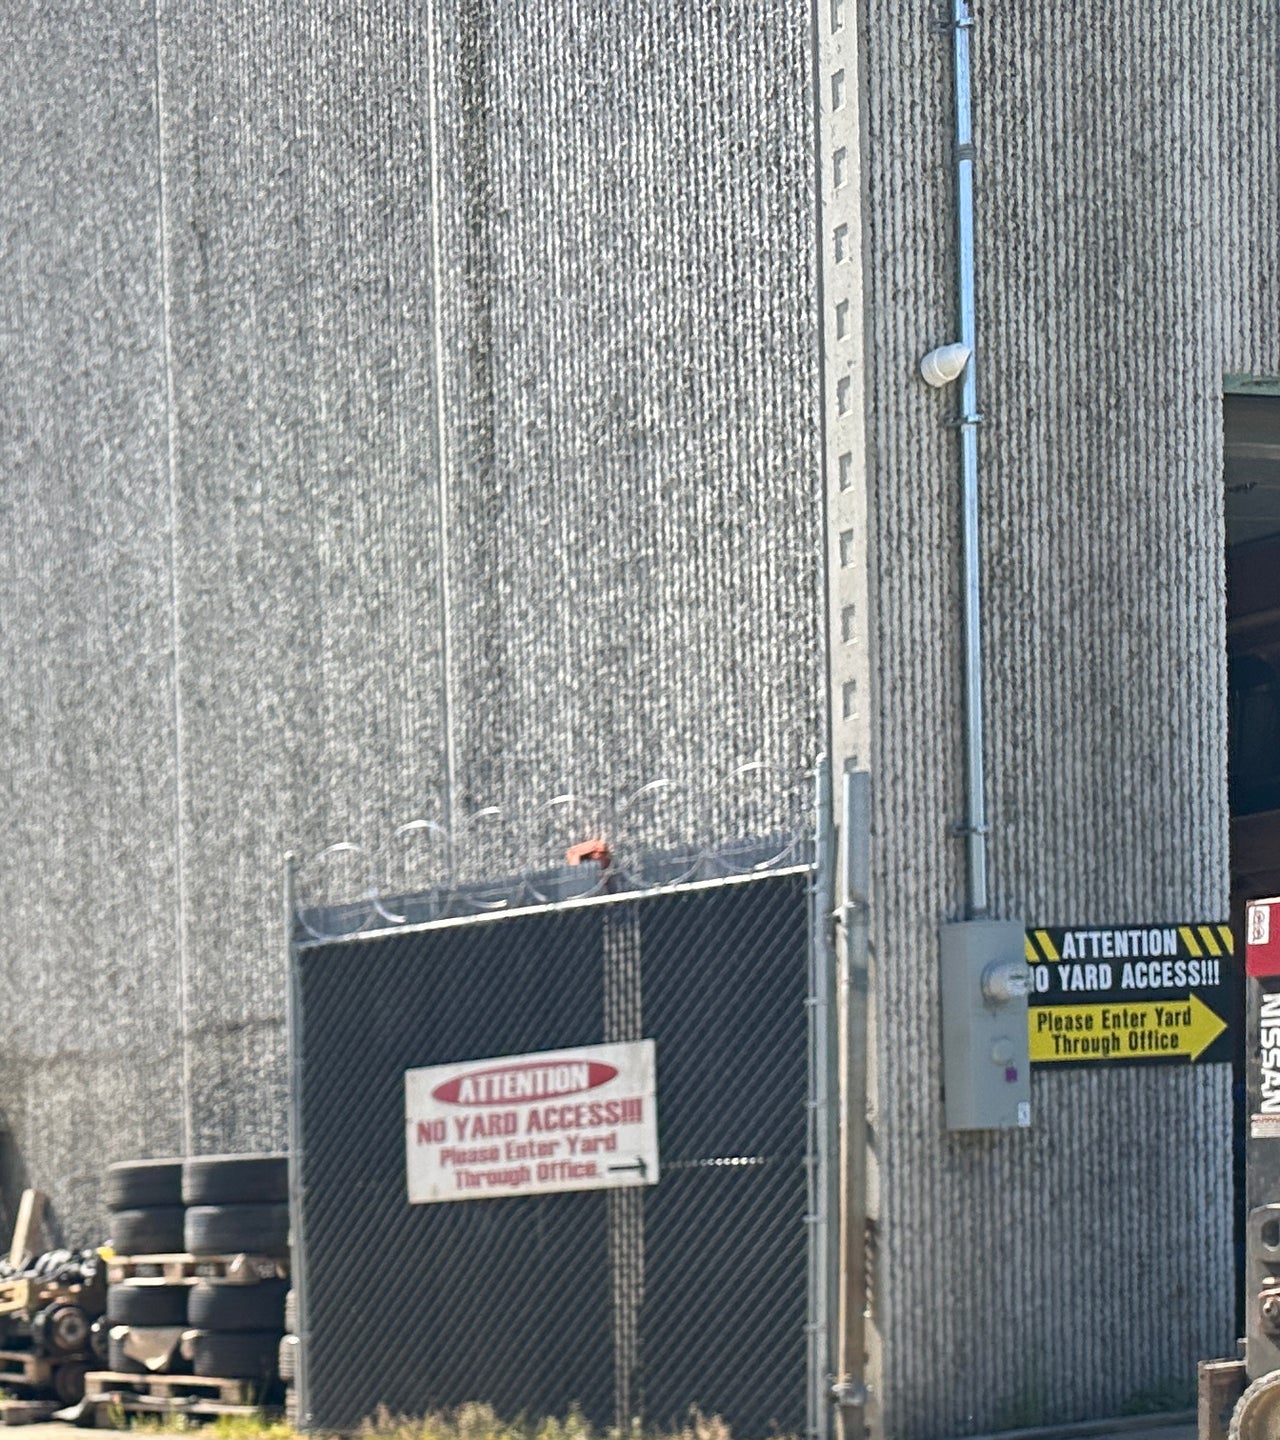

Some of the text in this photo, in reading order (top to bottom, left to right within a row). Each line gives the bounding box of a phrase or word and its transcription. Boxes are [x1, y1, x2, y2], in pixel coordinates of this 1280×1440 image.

[1062, 929, 1178, 960] ATTENTION
[1058, 963, 1112, 991] YARD
[1121, 960, 1220, 989] ACCESS!!!
[1037, 1006, 1192, 1034] Please Enter Yard
[1052, 1030, 1180, 1057] Through Office
[457, 1063, 590, 1104] ATTENTION
[416, 1097, 642, 1146] NO YARD ACCESS!!!
[439, 1131, 617, 1168] Please Enter Yard
[455, 1166, 530, 1189] Through
